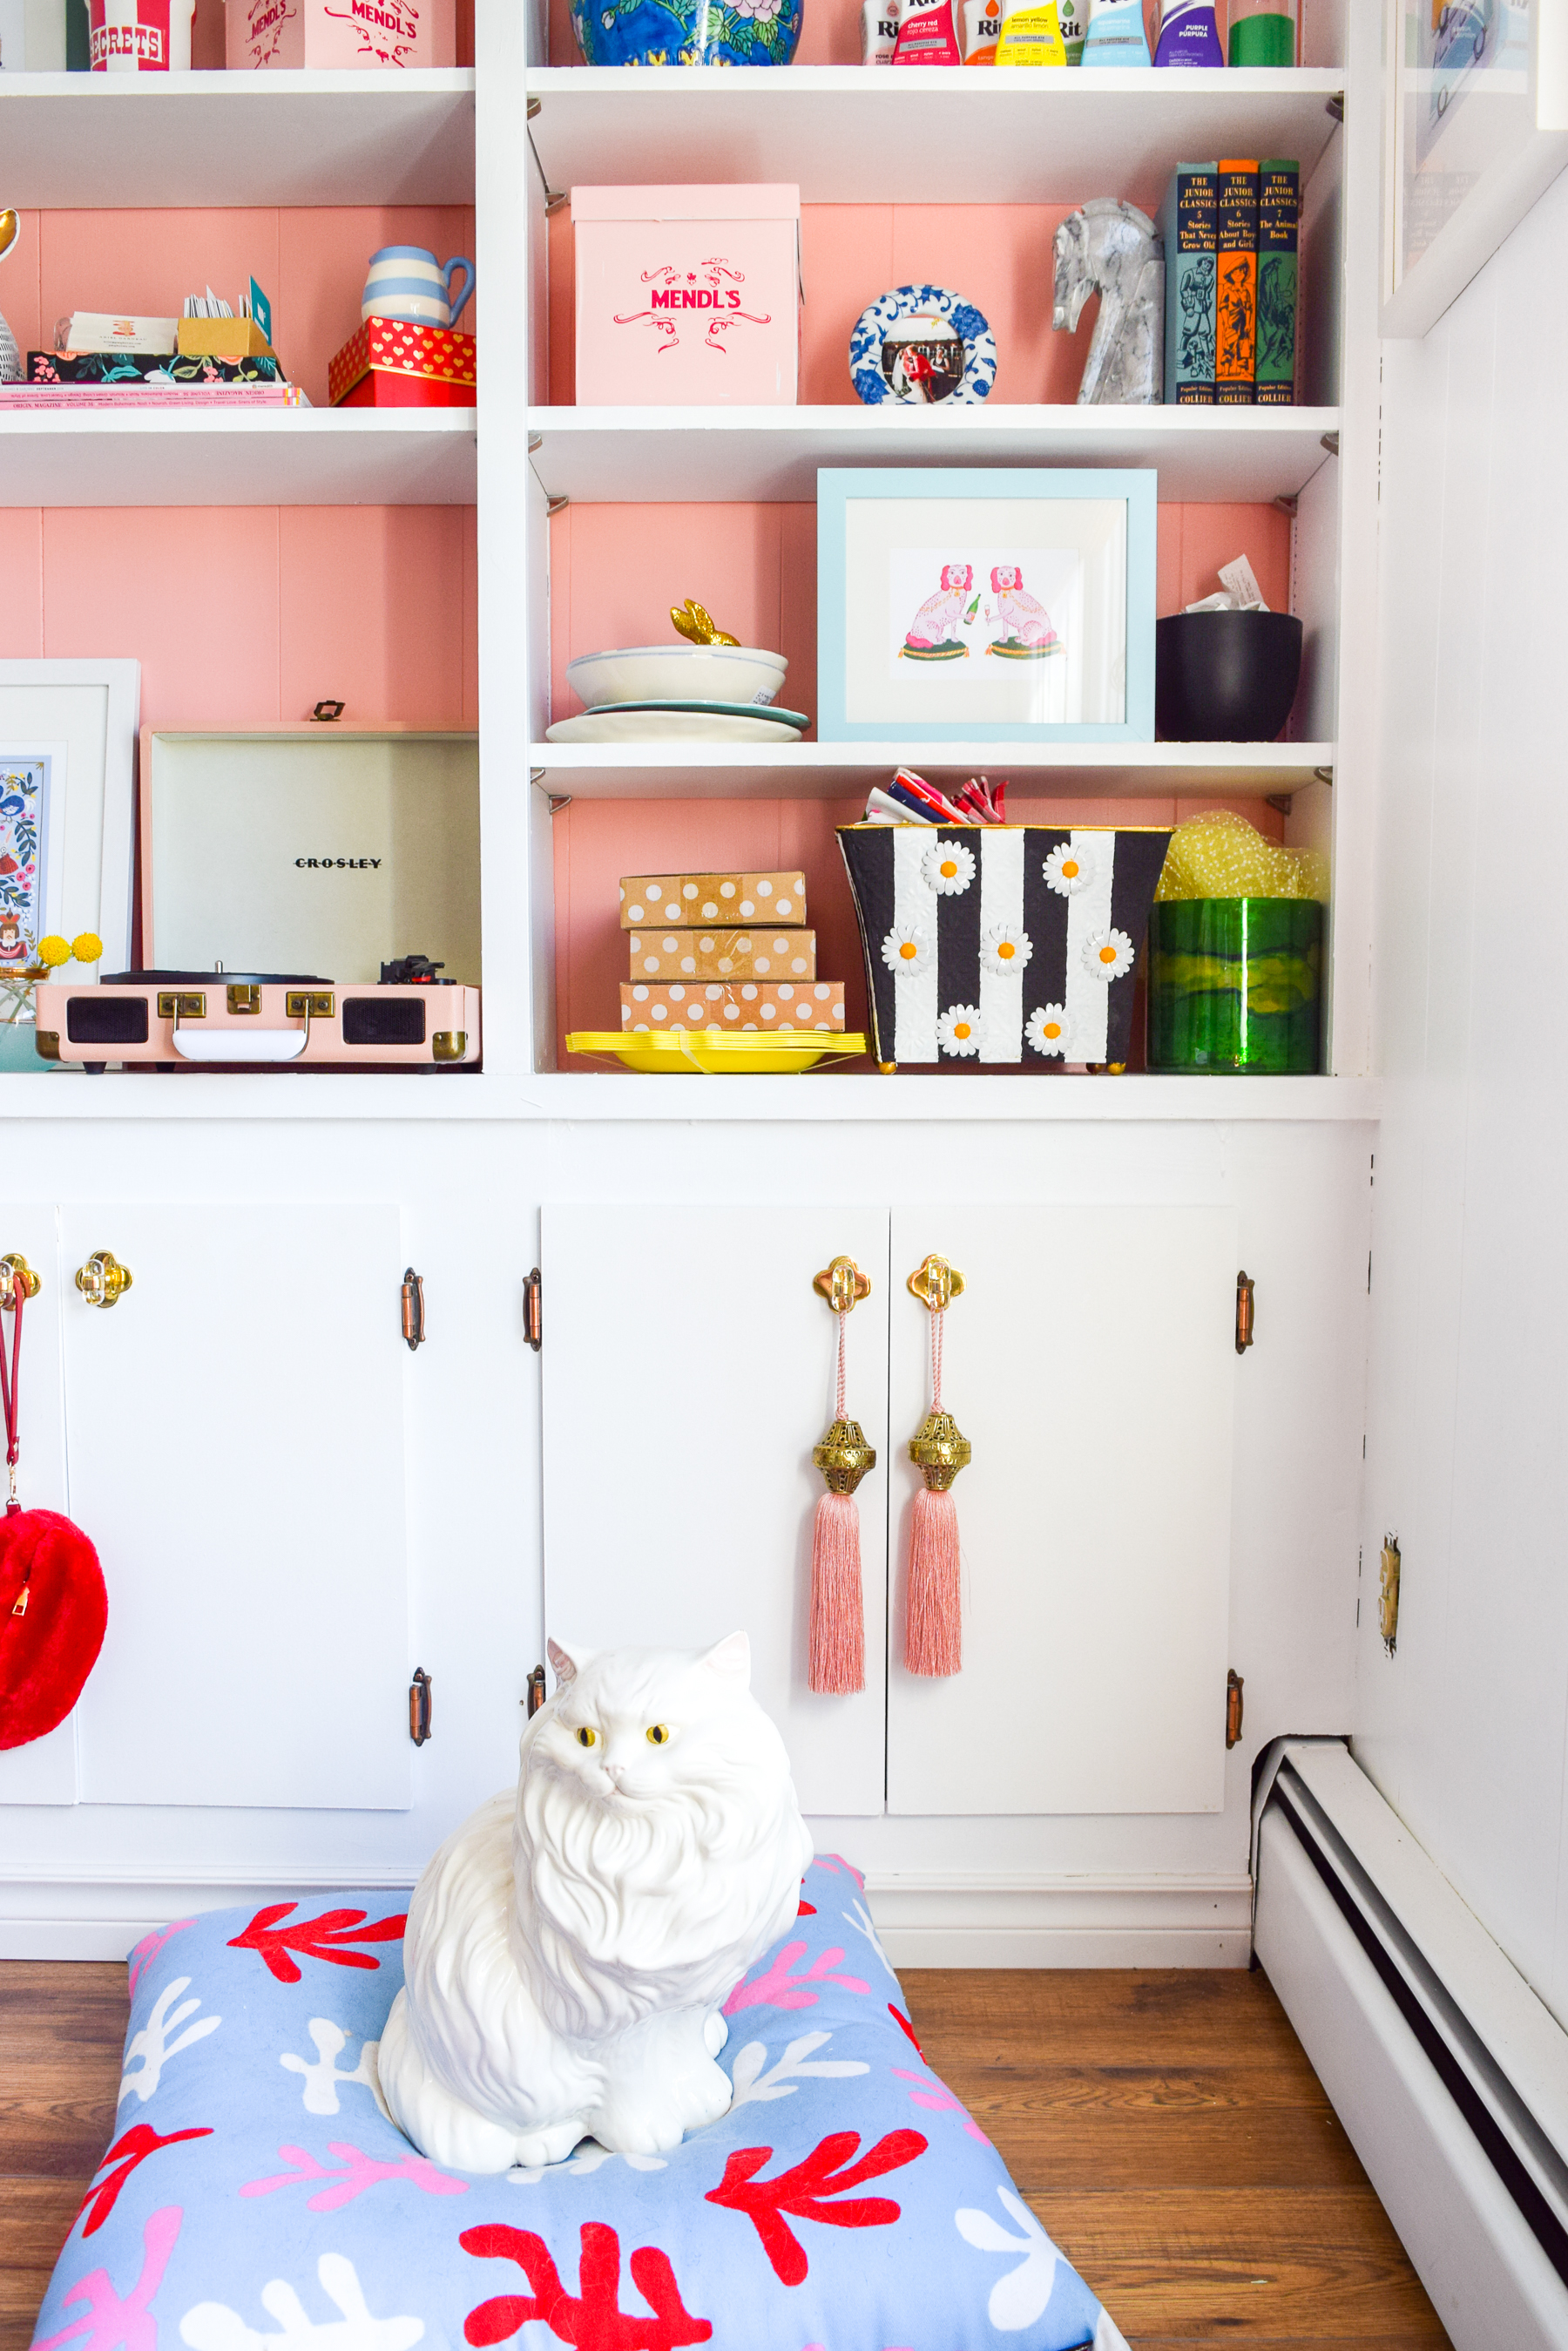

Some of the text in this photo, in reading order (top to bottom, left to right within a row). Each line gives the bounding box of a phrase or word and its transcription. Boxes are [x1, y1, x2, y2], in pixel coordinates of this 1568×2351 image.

[352, 0, 417, 39] MENDL'S
[877, 21, 899, 38] Ri
[977, 19, 1001, 36] Ri
[1059, 22, 1082, 38] Rit
[1191, 177, 1207, 186] THE
[1231, 176, 1247, 185] THE
[1271, 176, 1287, 184] THE
[1184, 189, 1213, 198] JUNIOR
[1224, 188, 1253, 197] JUNIOR
[1264, 187, 1293, 196] JUNIOR
[1180, 200, 1217, 208] CLASSICS
[1220, 199, 1257, 207] CLASSICS
[1260, 198, 1297, 207] CLASSICS
[1197, 210, 1202, 219] 5
[1188, 220, 1211, 229] Stories
[1275, 220, 1297, 229] Animal
[1220, 230, 1239, 238] About
[1270, 231, 1288, 239] Book
[1183, 240, 1215, 249] Grow Old
[651, 289, 741, 309] MENDL'S
[1180, 394, 1213, 403] COLLIER
[1219, 394, 1251, 403] COLLIER
[1258, 394, 1291, 403] COLLIER
[295, 858, 382, 869] CROSLEY
